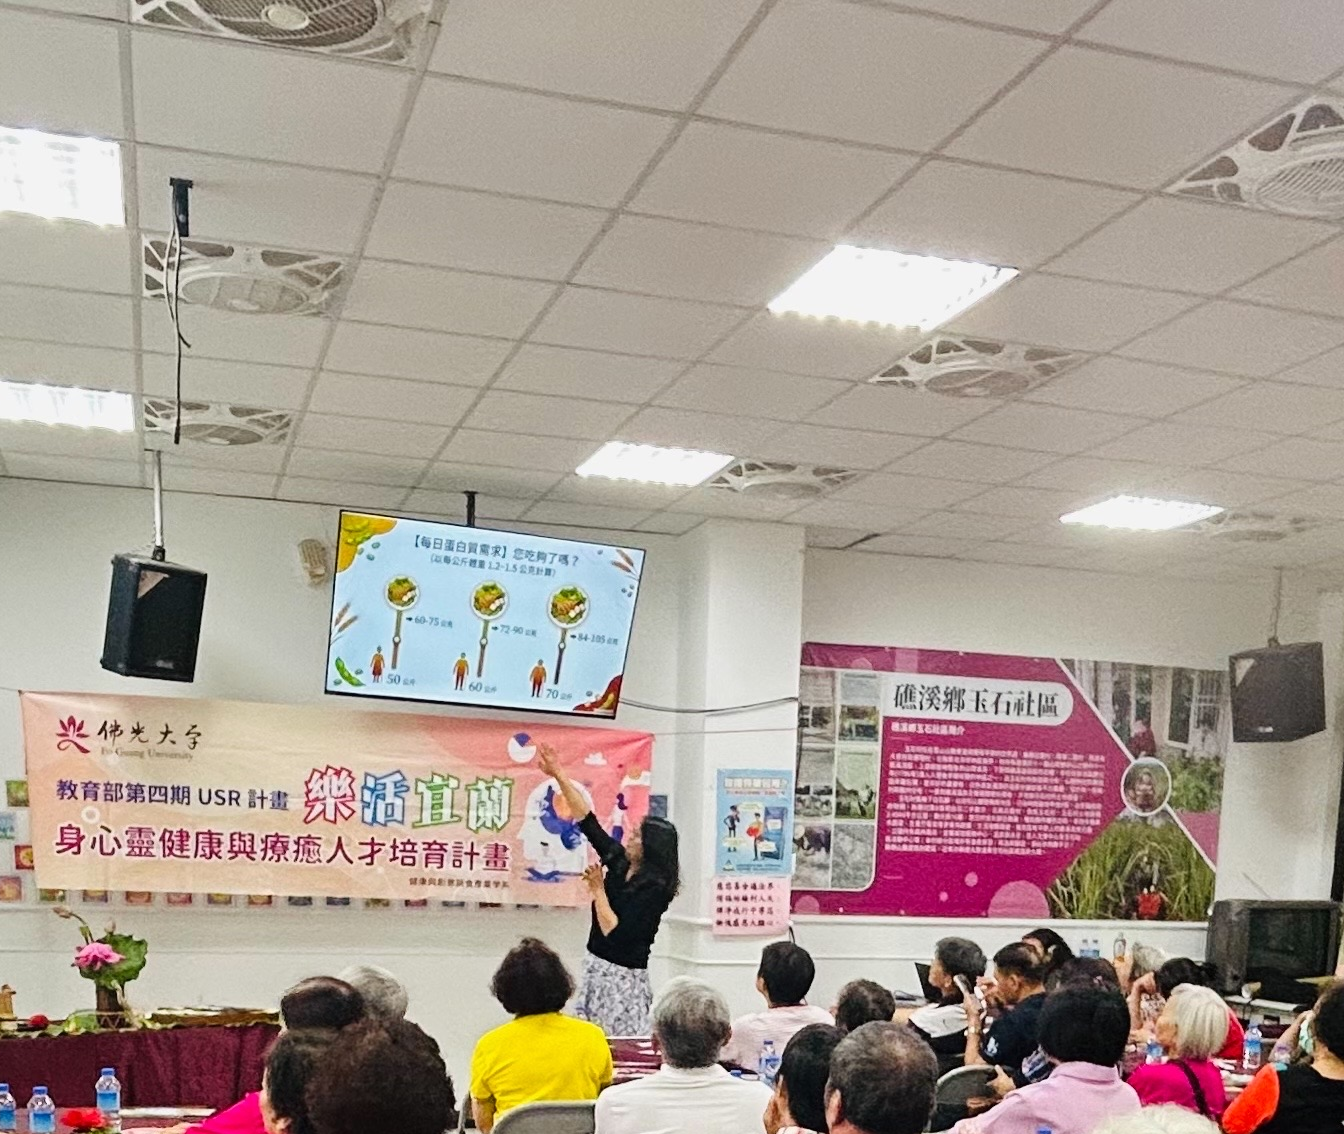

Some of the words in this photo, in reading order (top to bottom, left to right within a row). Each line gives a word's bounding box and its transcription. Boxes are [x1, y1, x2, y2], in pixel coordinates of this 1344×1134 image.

[386, 673, 401, 685] 50
[468, 681, 483, 693] 60
[546, 688, 559, 699] 70
[893, 682, 1060, 719] 礁溪鄉玉石社區
[56, 779, 191, 806] 教育部第四期
[198, 788, 241, 807] USR
[303, 764, 512, 834] 樂活宜蘭
